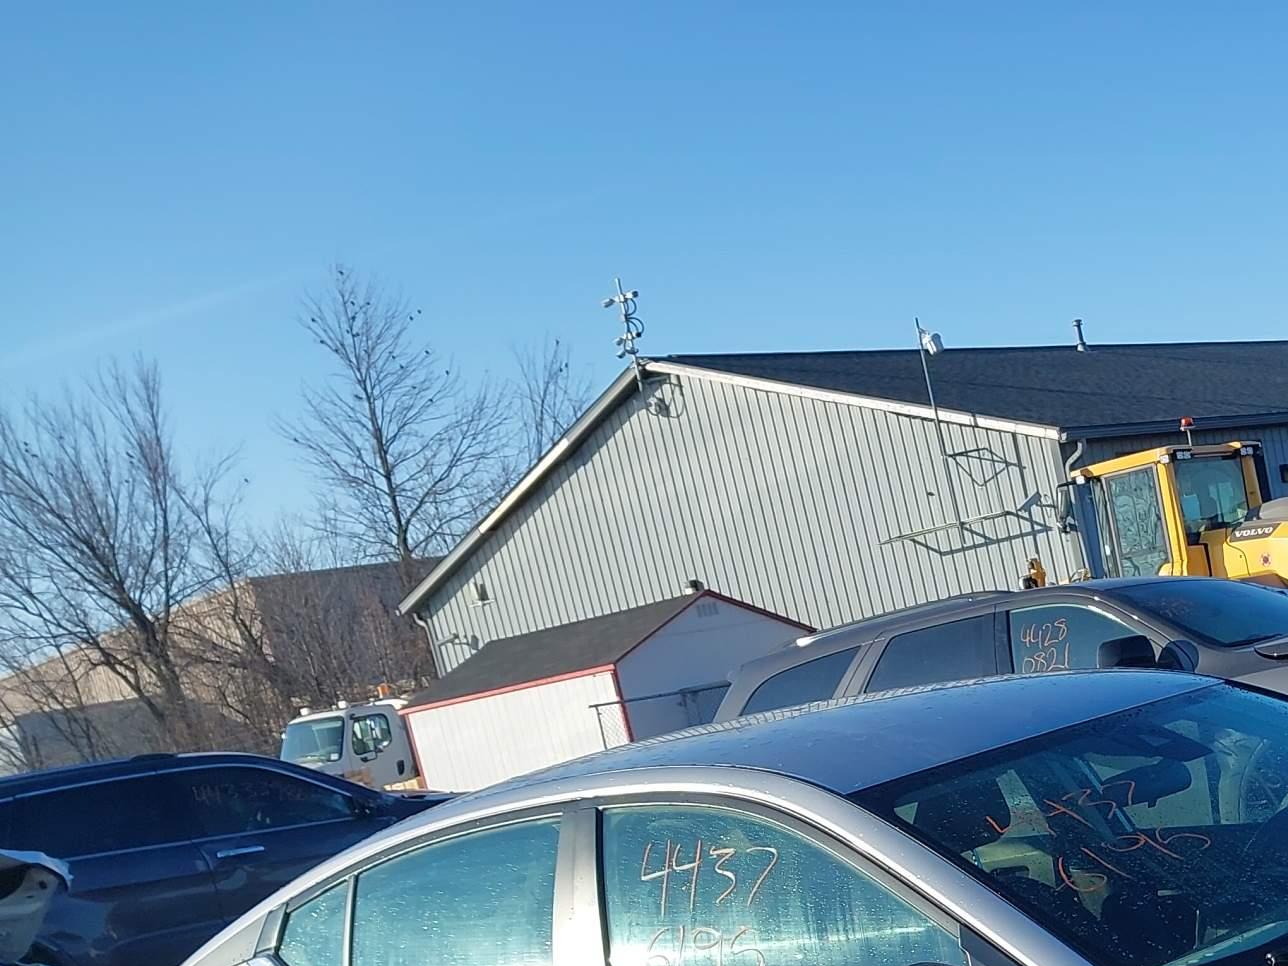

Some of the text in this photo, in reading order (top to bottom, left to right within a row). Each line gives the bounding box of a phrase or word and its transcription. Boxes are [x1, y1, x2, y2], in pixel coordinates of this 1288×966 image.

[1234, 526, 1274, 538] VOLVO
[1020, 617, 1068, 650] 4428
[641, 839, 778, 919] 4437
